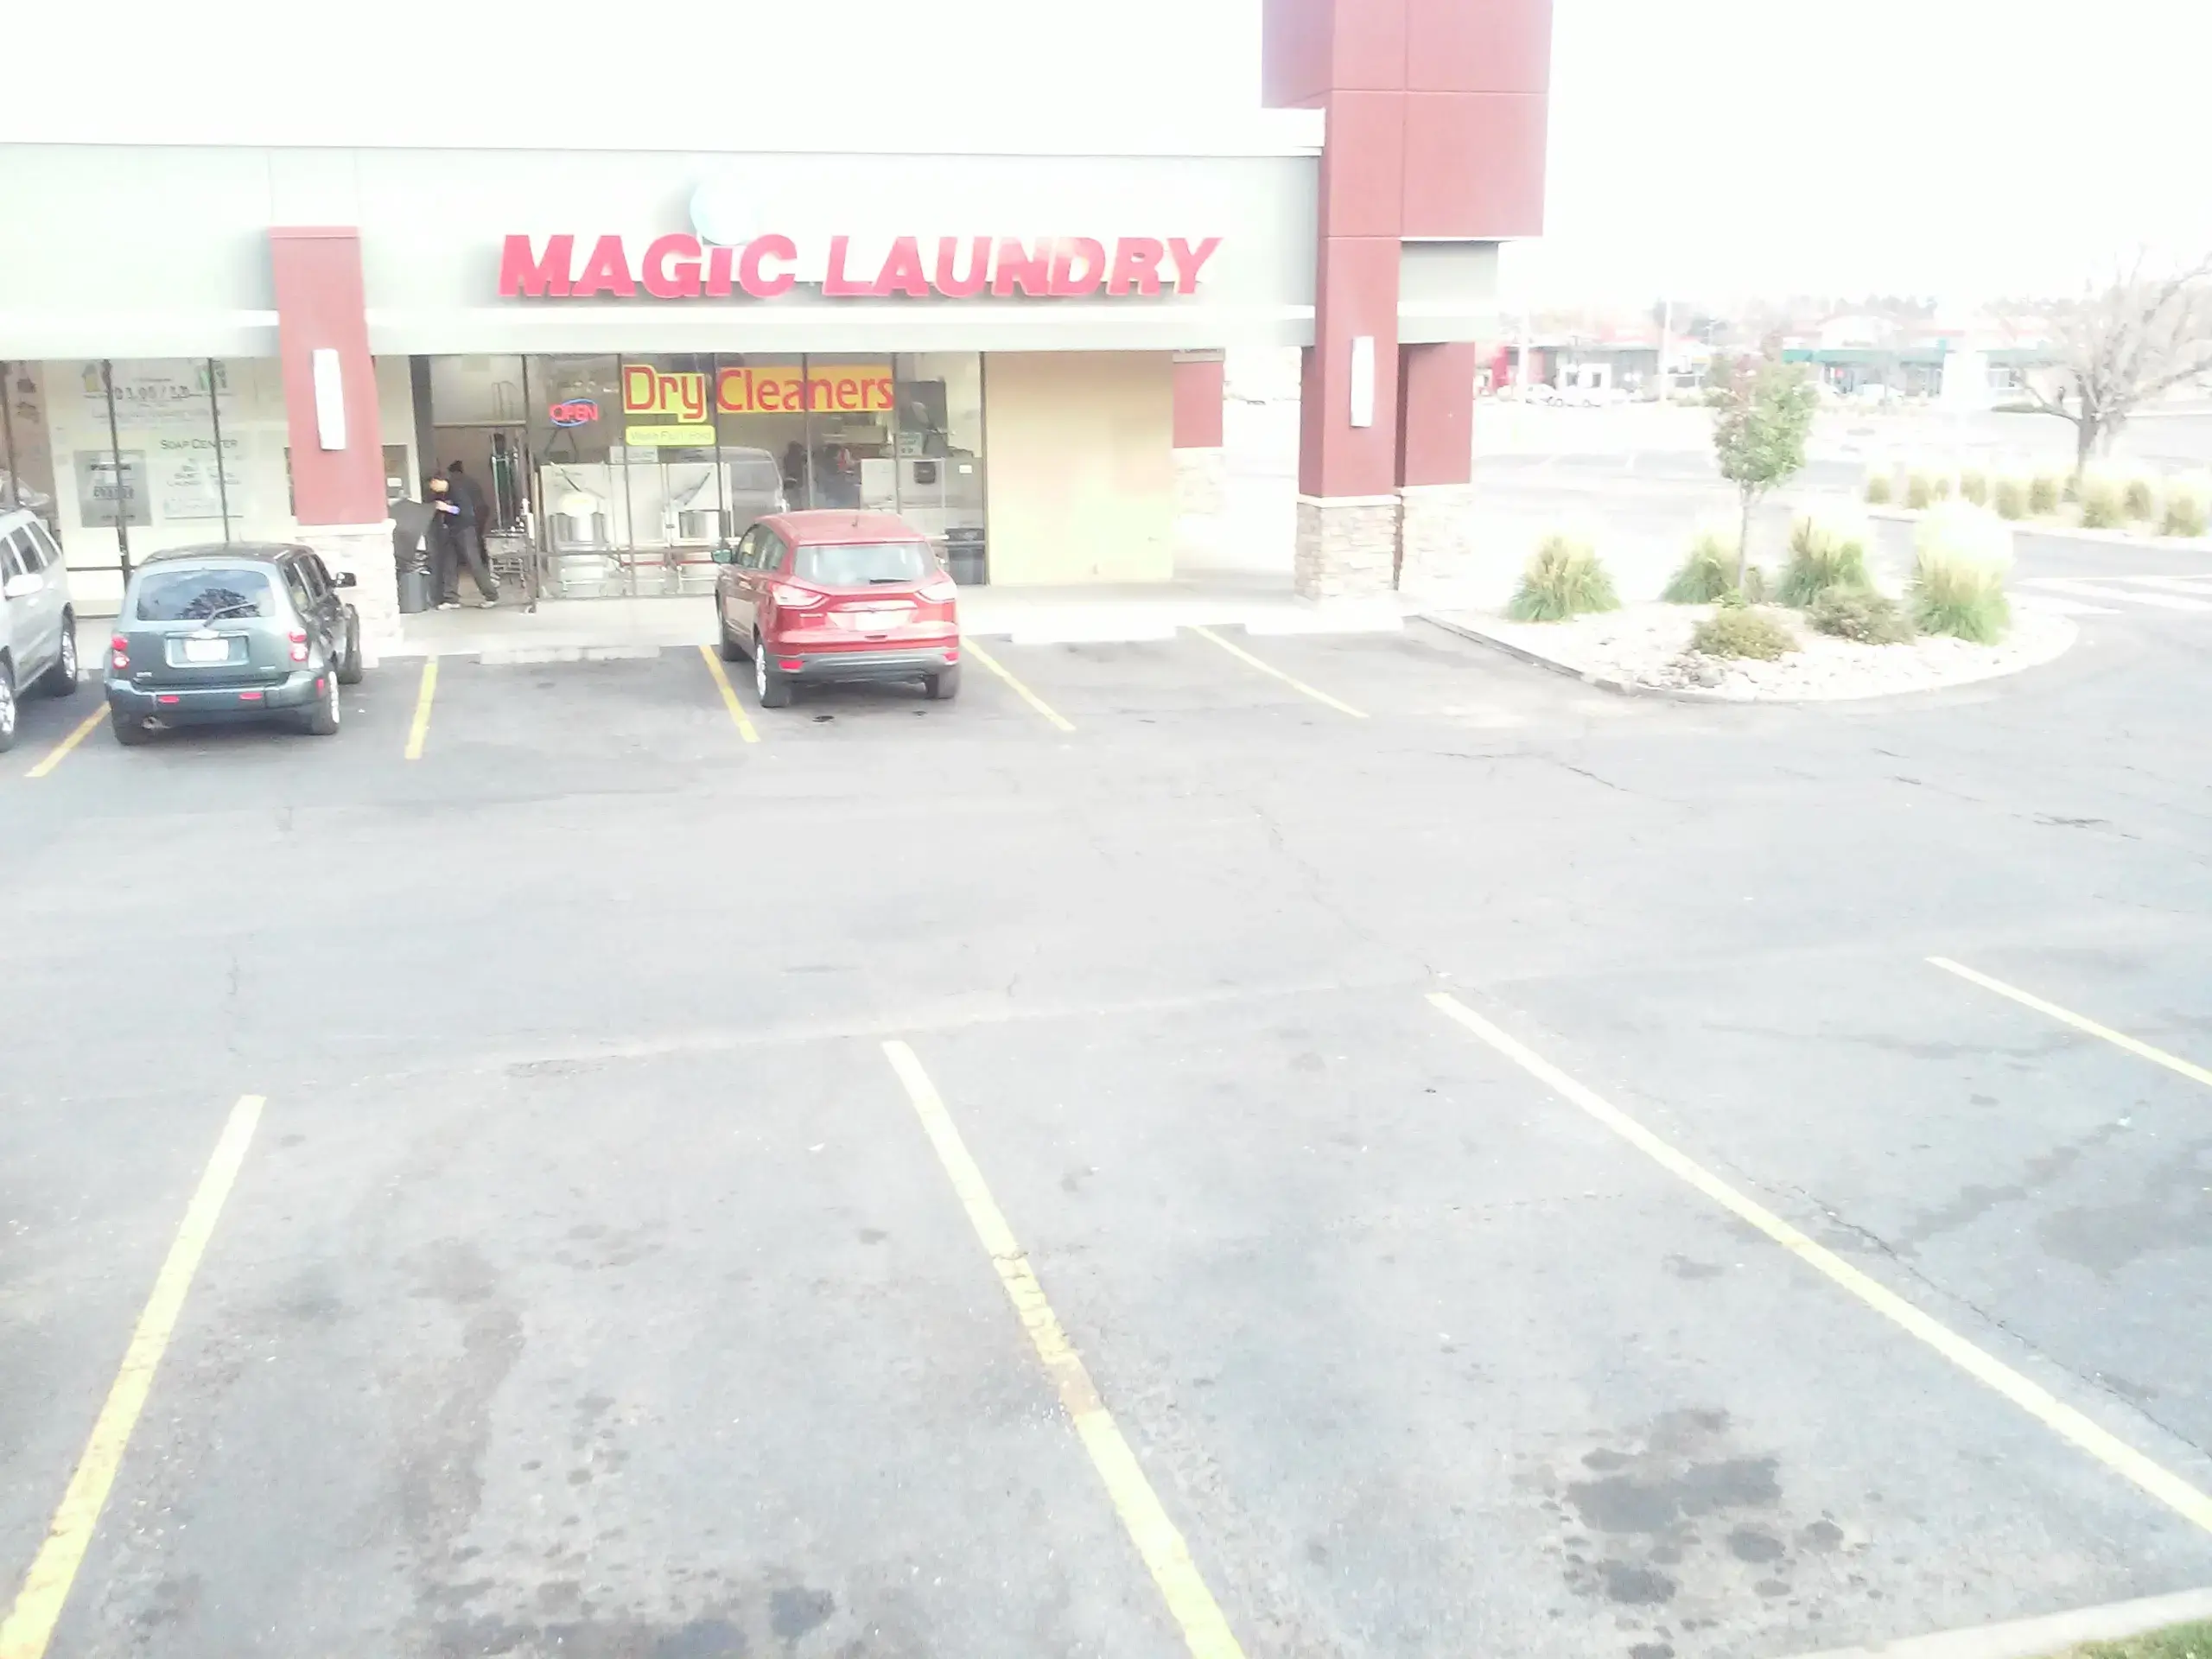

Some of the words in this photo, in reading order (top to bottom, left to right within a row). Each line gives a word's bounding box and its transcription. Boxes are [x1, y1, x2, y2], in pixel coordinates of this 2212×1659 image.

[821, 234, 1224, 298] LAUNDRY
[549, 404, 599, 422] OPEN
[623, 365, 704, 420] Dry
[716, 369, 894, 411] Cleaners
